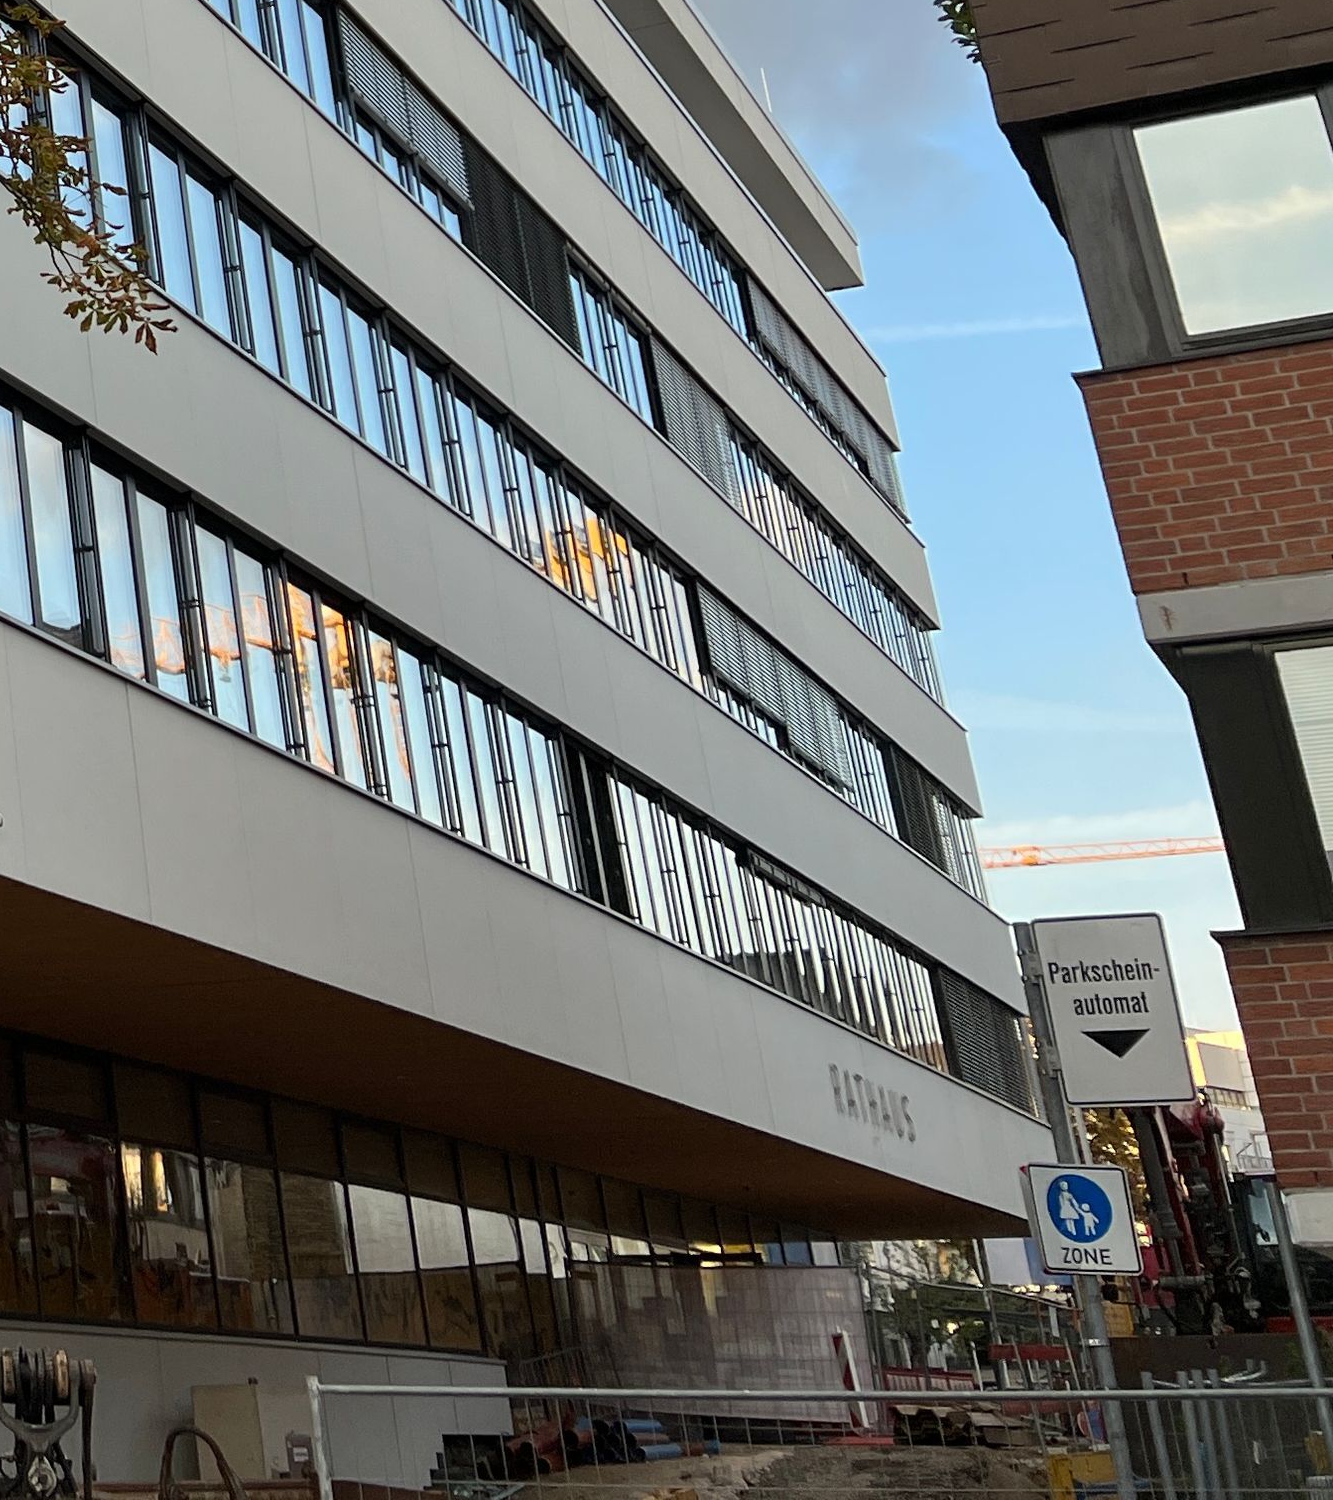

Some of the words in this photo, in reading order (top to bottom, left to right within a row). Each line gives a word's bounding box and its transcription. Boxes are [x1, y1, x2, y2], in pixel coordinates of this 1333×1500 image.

[1047, 957, 1160, 984] Parkschein-
[1073, 991, 1150, 1016] automat
[828, 1062, 916, 1143] RATHAUS
[1061, 1246, 1113, 1266] ZONE
